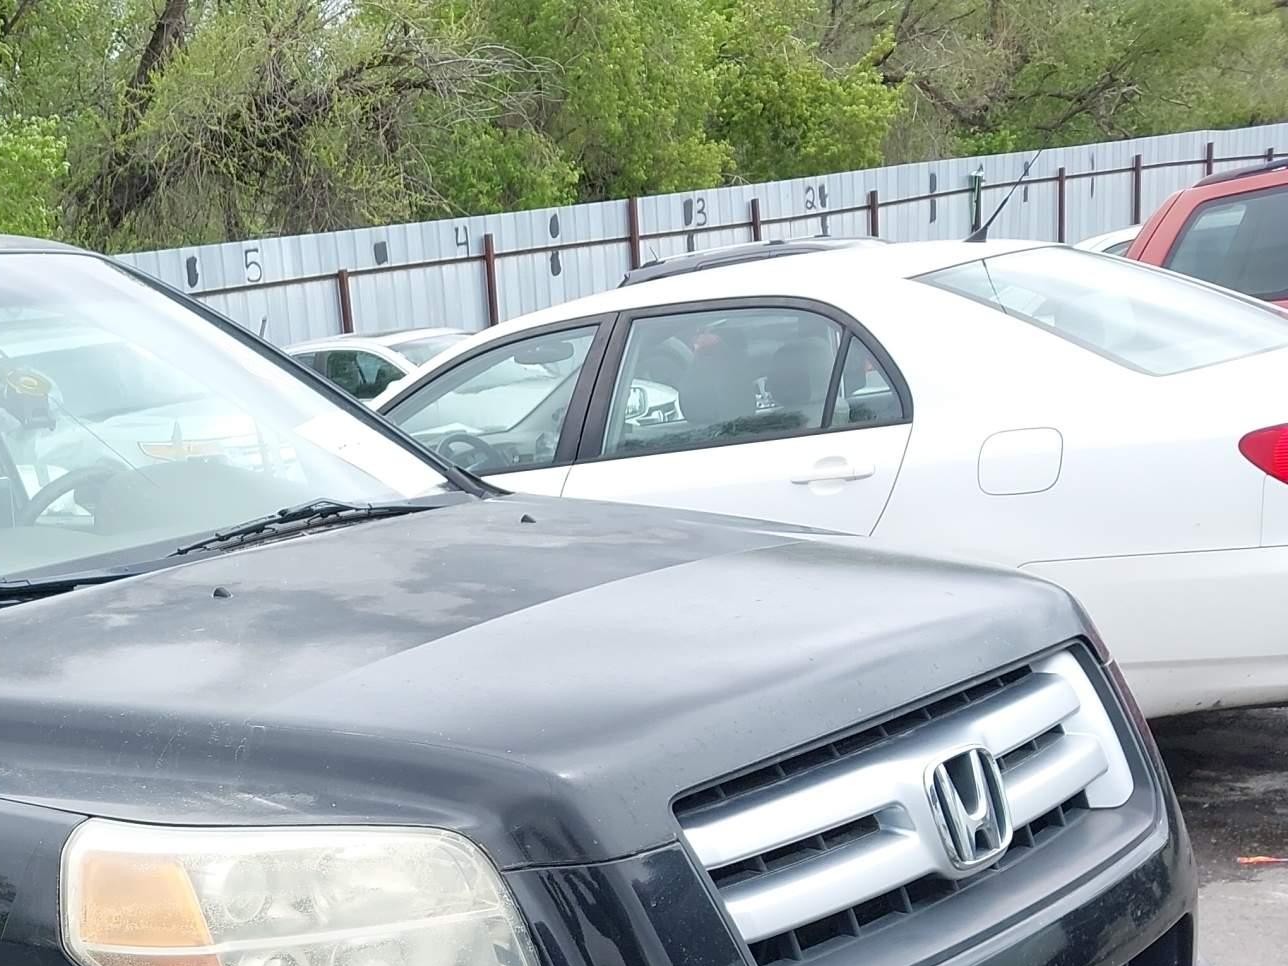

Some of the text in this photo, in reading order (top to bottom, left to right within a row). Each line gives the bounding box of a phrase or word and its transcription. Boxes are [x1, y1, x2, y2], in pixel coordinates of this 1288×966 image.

[695, 198, 708, 226] 3
[805, 185, 817, 210] 2
[454, 224, 470, 257] 4
[244, 247, 263, 283] 5
